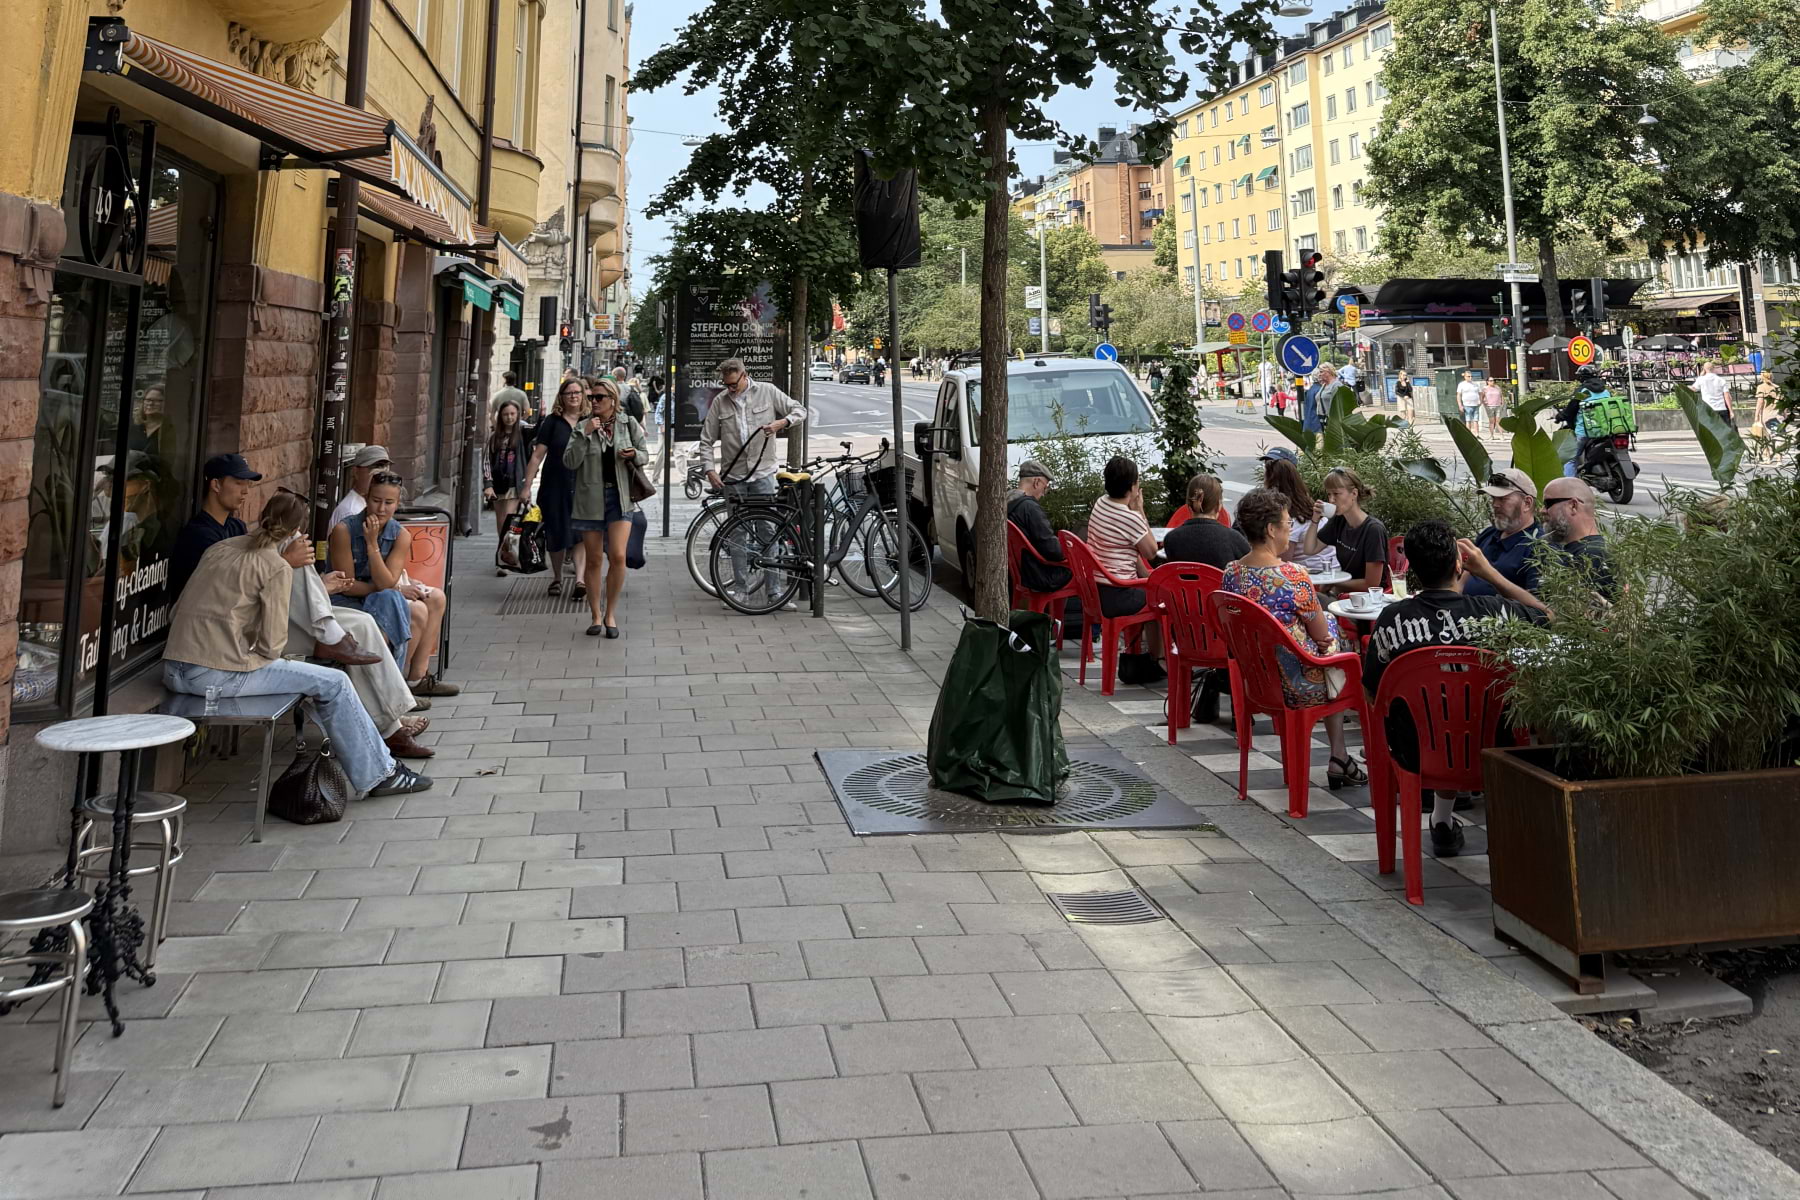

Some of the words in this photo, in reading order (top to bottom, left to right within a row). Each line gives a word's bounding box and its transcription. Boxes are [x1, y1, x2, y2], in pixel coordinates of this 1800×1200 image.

[95, 186, 113, 225] 49
[691, 323, 740, 332] STEFFLON
[742, 323, 764, 332] DON
[1573, 343, 1590, 358] 50
[116, 552, 170, 611] ry-cleaning
[130, 607, 141, 645] &
[141, 603, 170, 639] Laun
